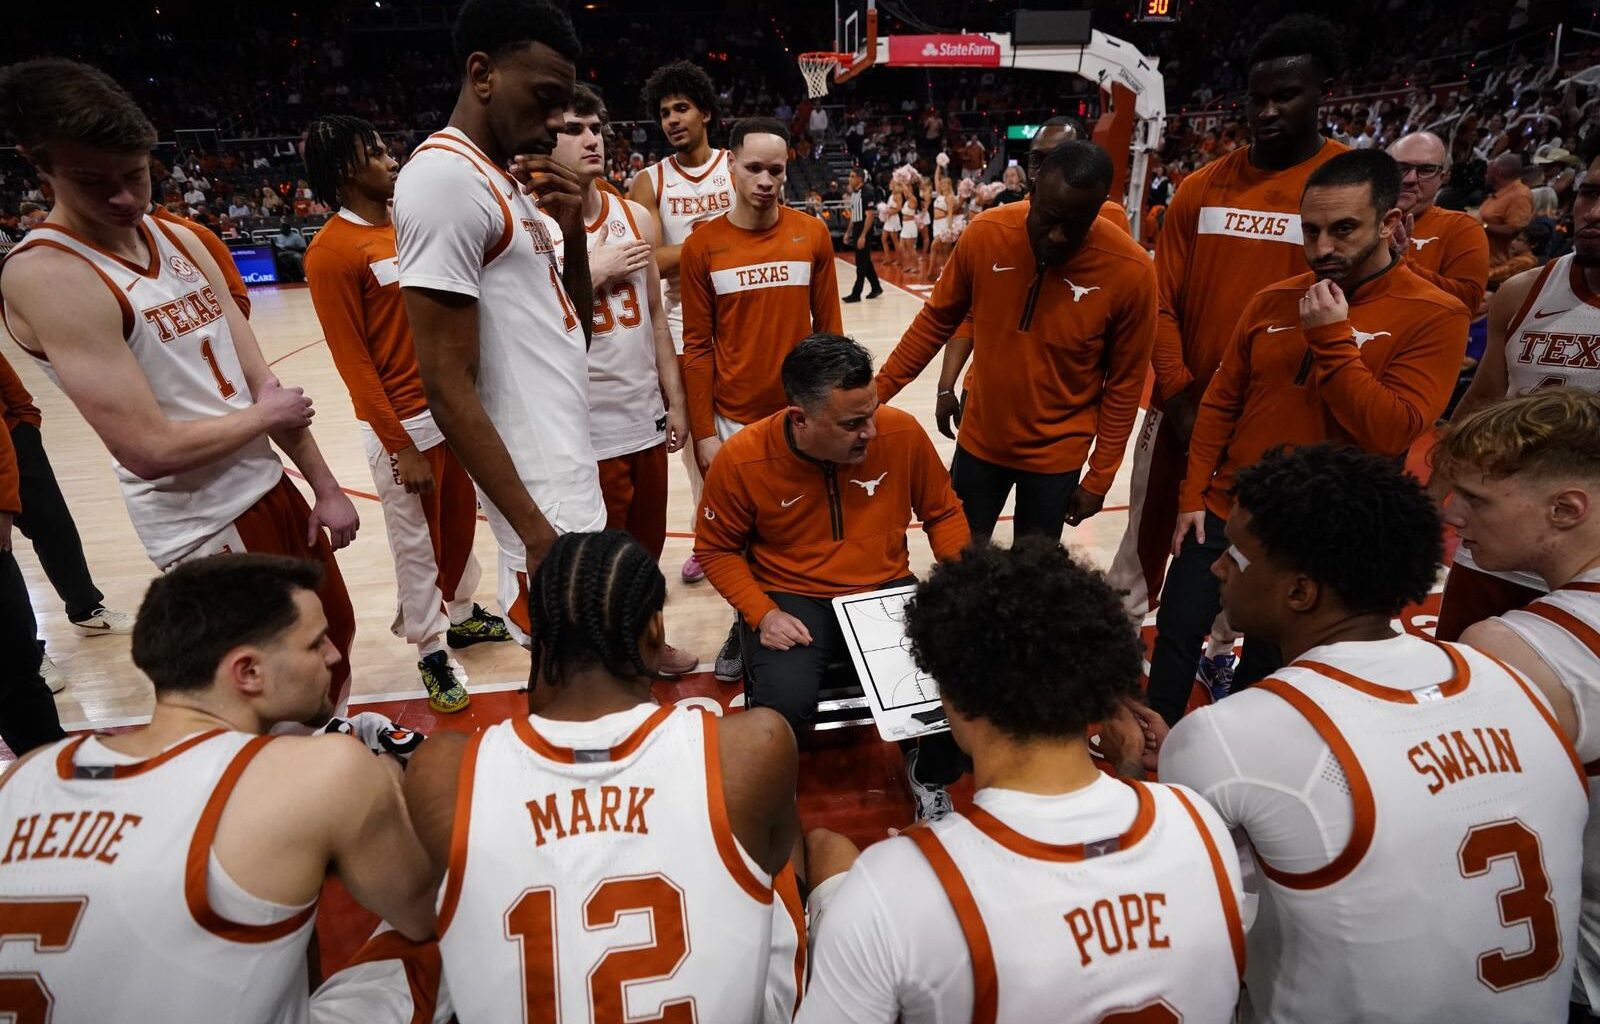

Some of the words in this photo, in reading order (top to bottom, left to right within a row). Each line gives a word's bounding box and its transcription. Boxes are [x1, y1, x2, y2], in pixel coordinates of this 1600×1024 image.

[1148, 0, 1168, 14] 30
[940, 42, 995, 56] StateFarm
[667, 191, 731, 216] TEXAS
[1224, 212, 1289, 236] TEXAS
[736, 265, 789, 287] TEXAS
[142, 286, 224, 343] TEXAS
[201, 337, 237, 400] 1
[1407, 727, 1523, 796] SWAIN
[1, 811, 143, 865] HEIDE
[525, 785, 655, 848] MARK
[1063, 892, 1171, 968] POPE
[1457, 816, 1563, 993] 3
[503, 871, 699, 1024] 12
